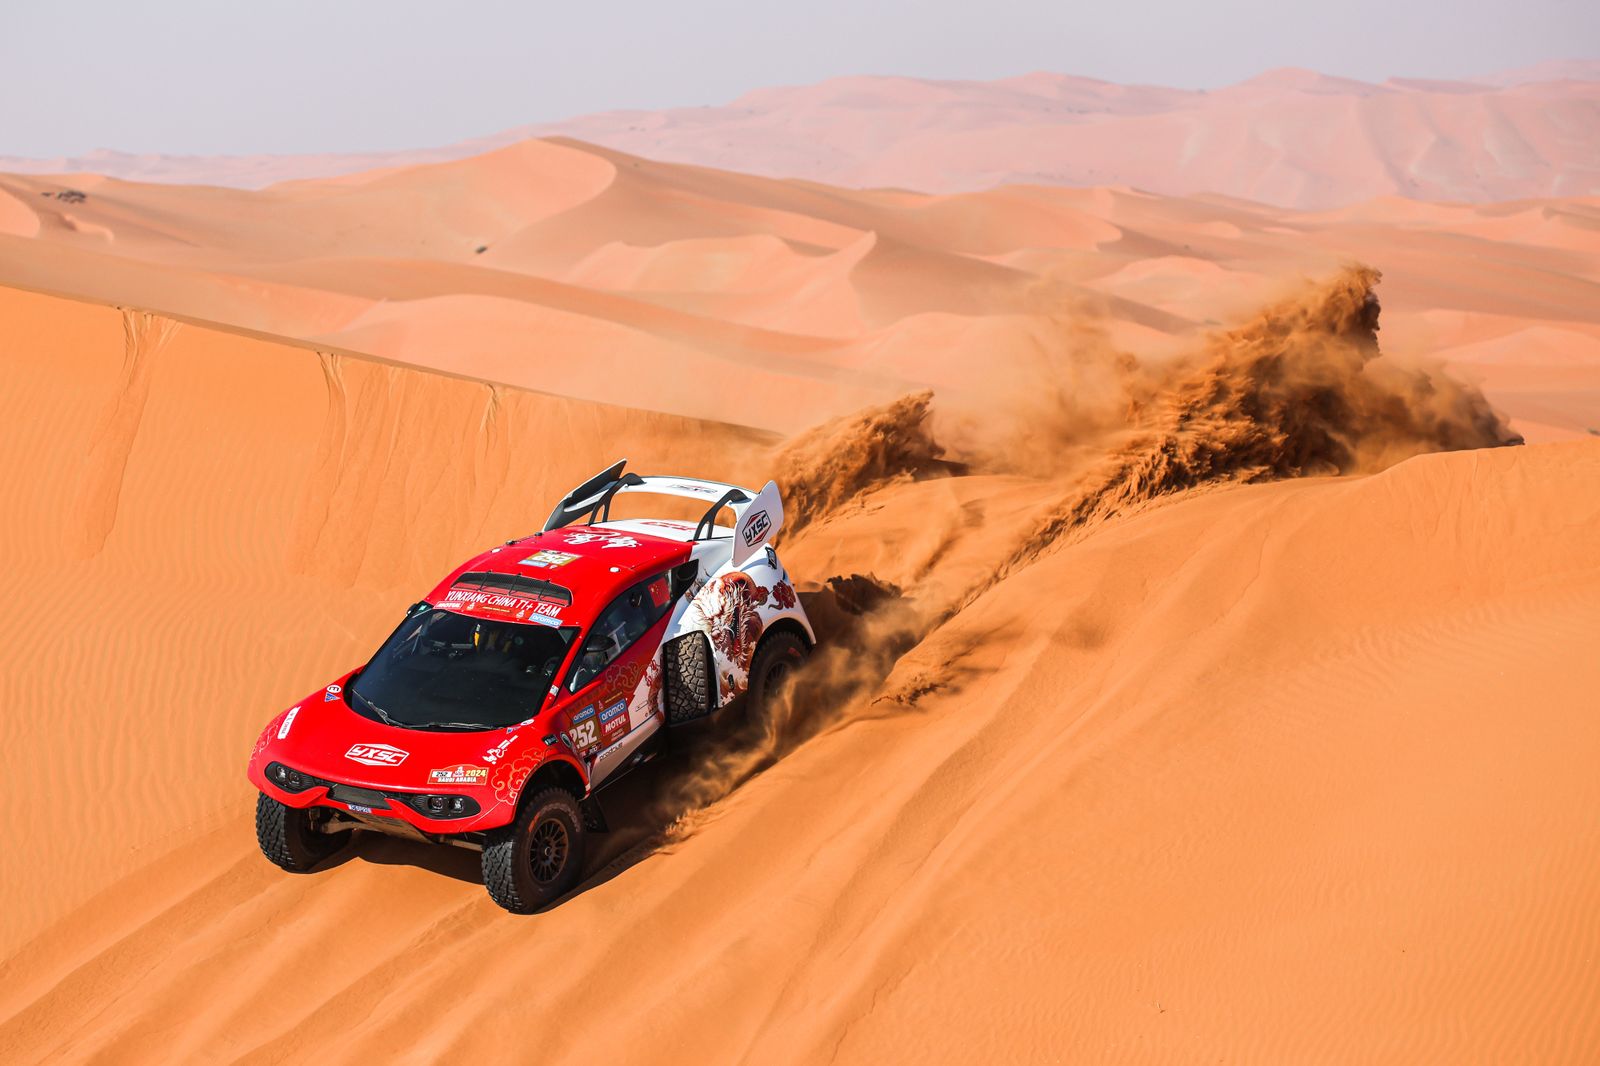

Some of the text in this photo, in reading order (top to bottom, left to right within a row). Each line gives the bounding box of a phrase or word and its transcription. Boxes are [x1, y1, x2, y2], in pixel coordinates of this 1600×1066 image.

[744, 513, 769, 543] YXSC
[445, 591, 488, 604] YUNXIANG
[488, 596, 517, 608] CHINA
[516, 600, 533, 611] T1+
[533, 602, 561, 617] TEAM
[573, 707, 594, 721] aramco
[601, 702, 625, 721] aramco
[605, 714, 627, 733] MOTUL
[569, 720, 597, 749] 252
[348, 746, 406, 763] YXSC
[465, 769, 487, 777] 2024
